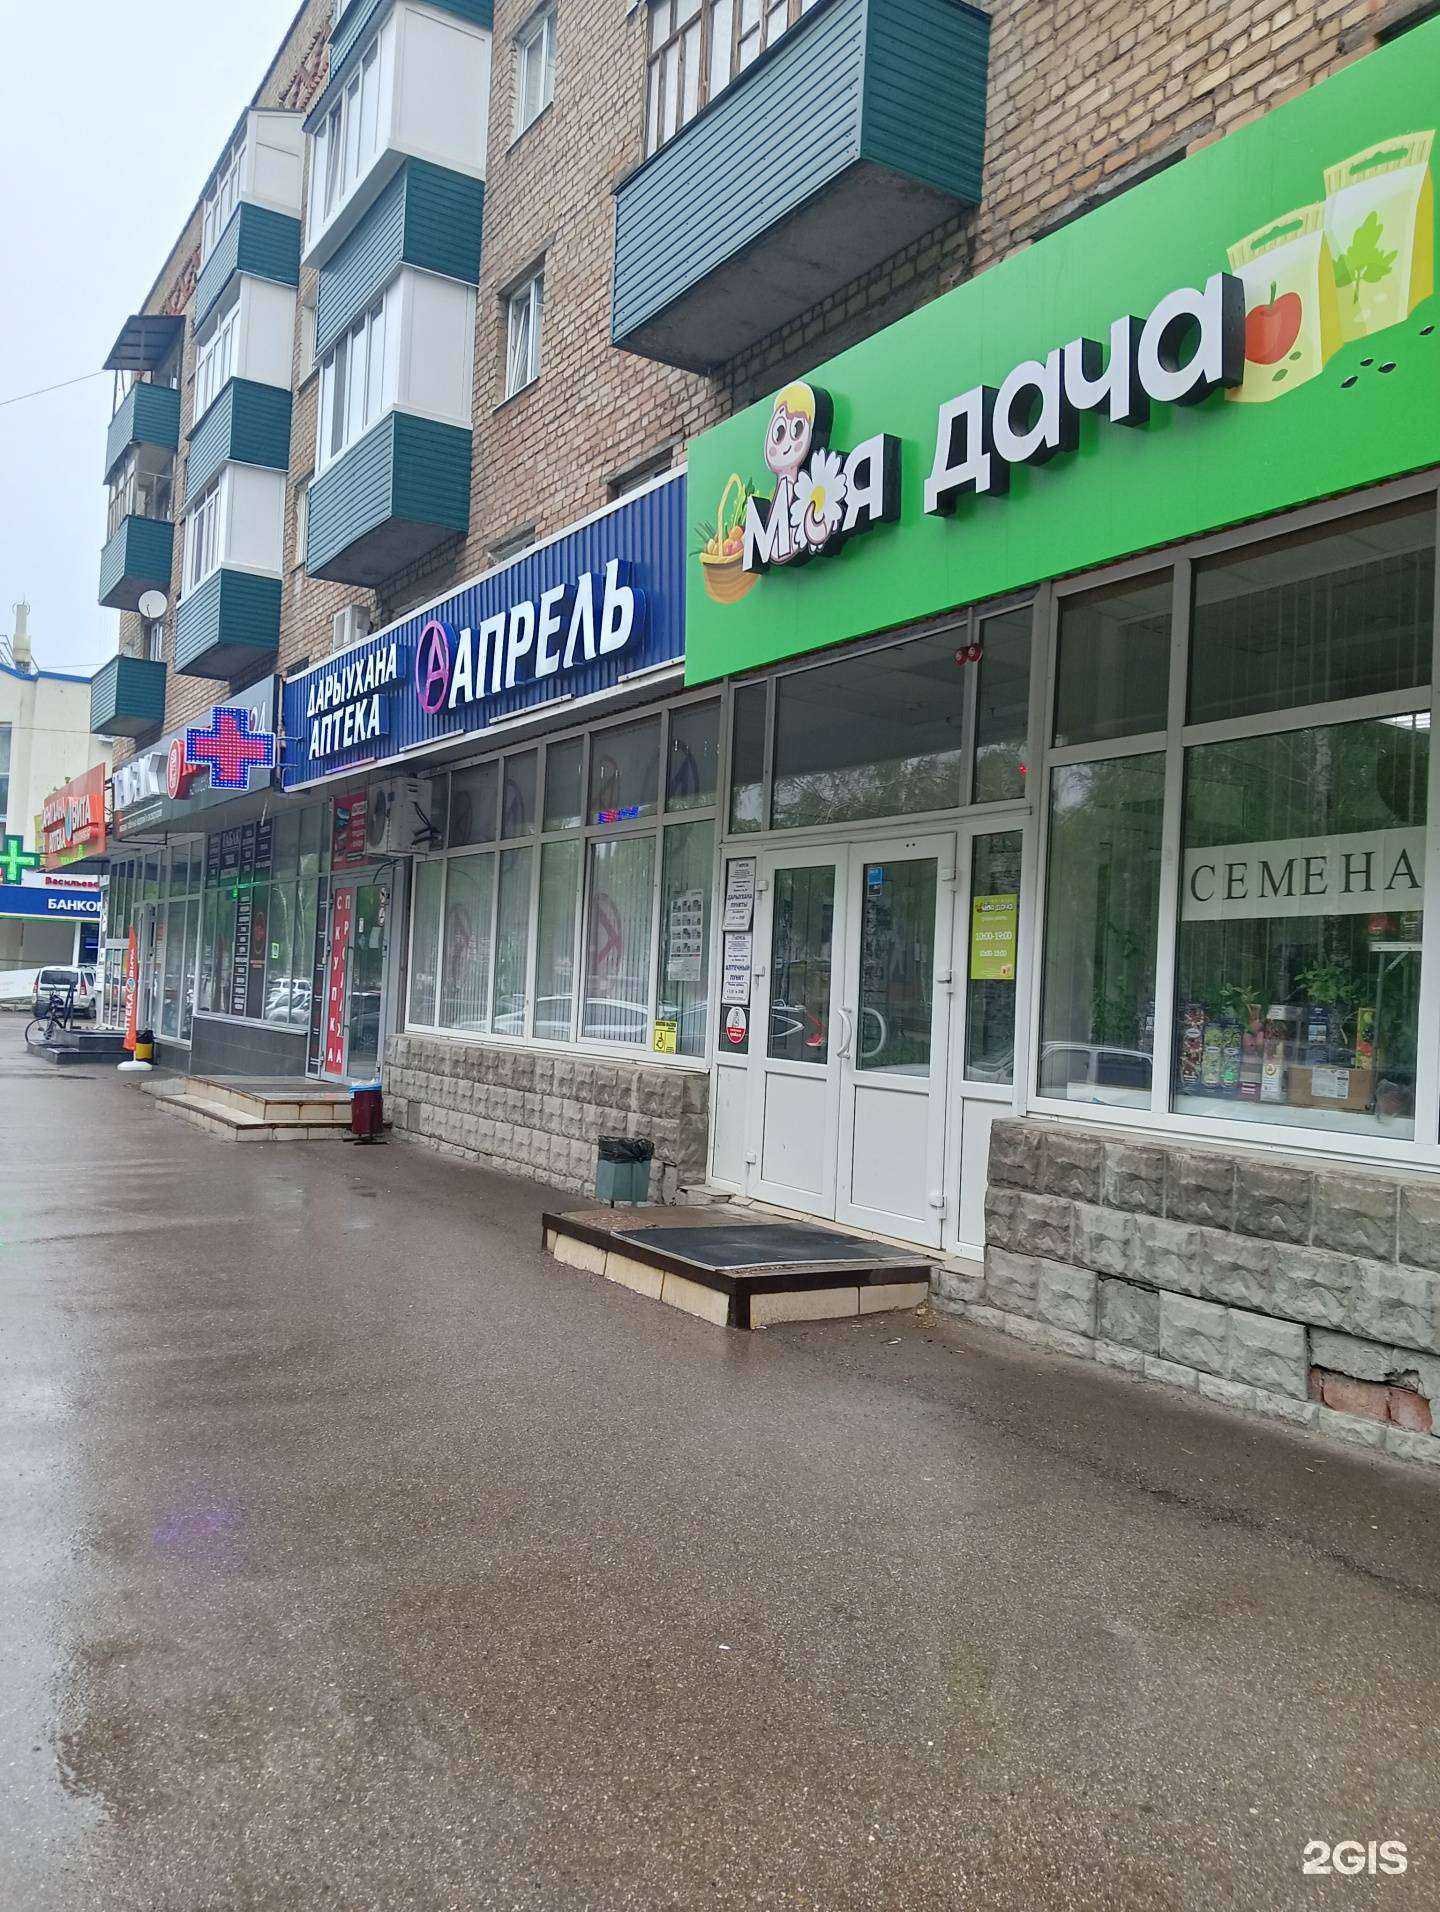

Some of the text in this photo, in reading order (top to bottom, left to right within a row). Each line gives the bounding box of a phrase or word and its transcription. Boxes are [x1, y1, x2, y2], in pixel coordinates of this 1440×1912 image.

[924, 272, 1226, 516] дача
[306, 643, 399, 719] ДАРЫУХАНА
[448, 557, 636, 709] АПРЕЛЬ
[308, 694, 381, 761] АПТЕКА
[1190, 847, 1422, 902] СЕМЕНА
[326, 896, 343, 1063] СКУПКА
